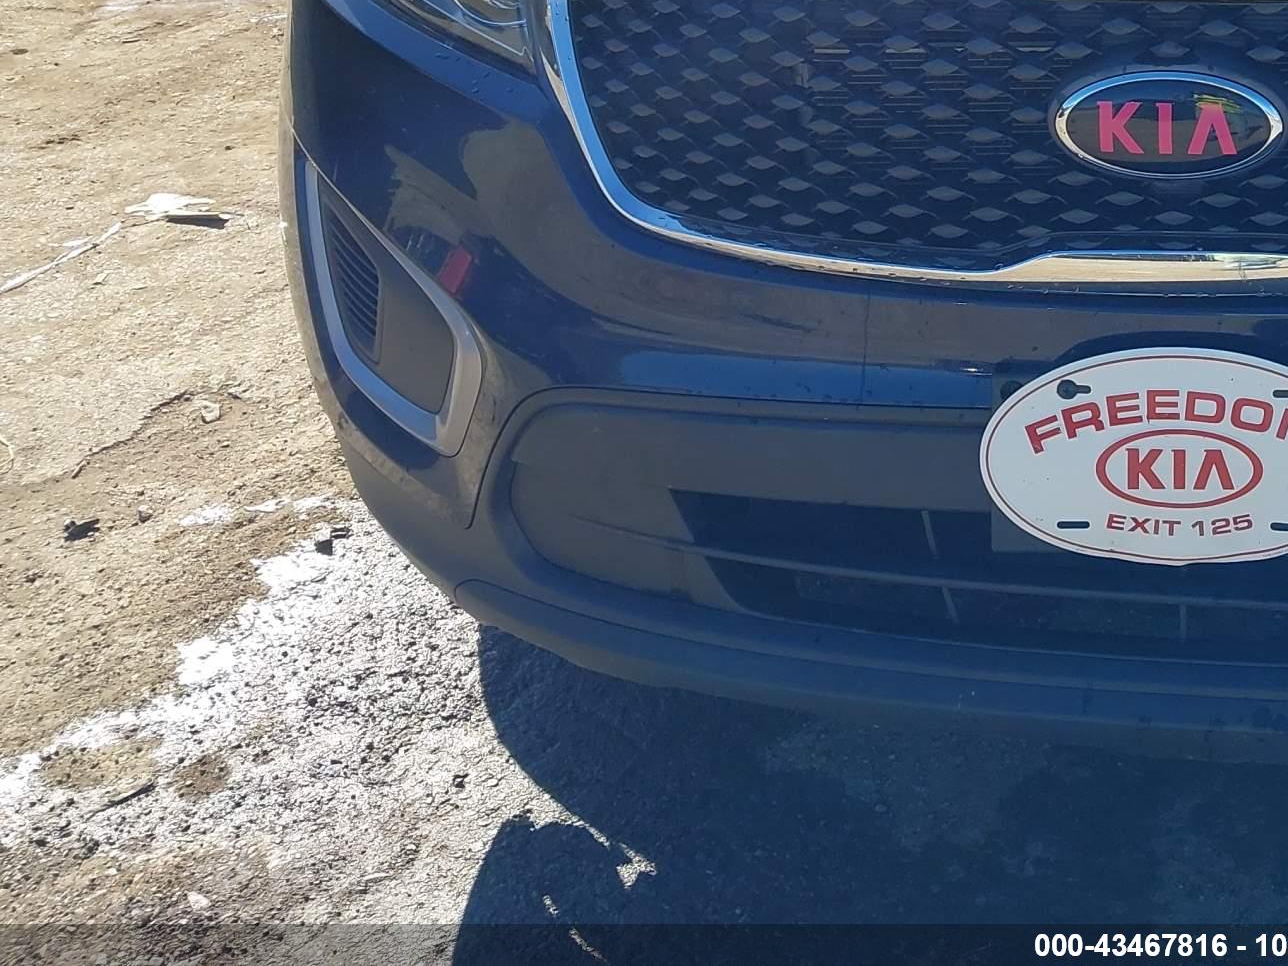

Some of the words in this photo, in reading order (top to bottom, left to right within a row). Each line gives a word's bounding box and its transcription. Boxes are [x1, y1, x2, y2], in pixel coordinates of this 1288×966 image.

[1096, 100, 1238, 155] KIA
[1125, 448, 1235, 491] KIA
[1106, 512, 1181, 536] EXIT
[1192, 513, 1253, 536] 125
